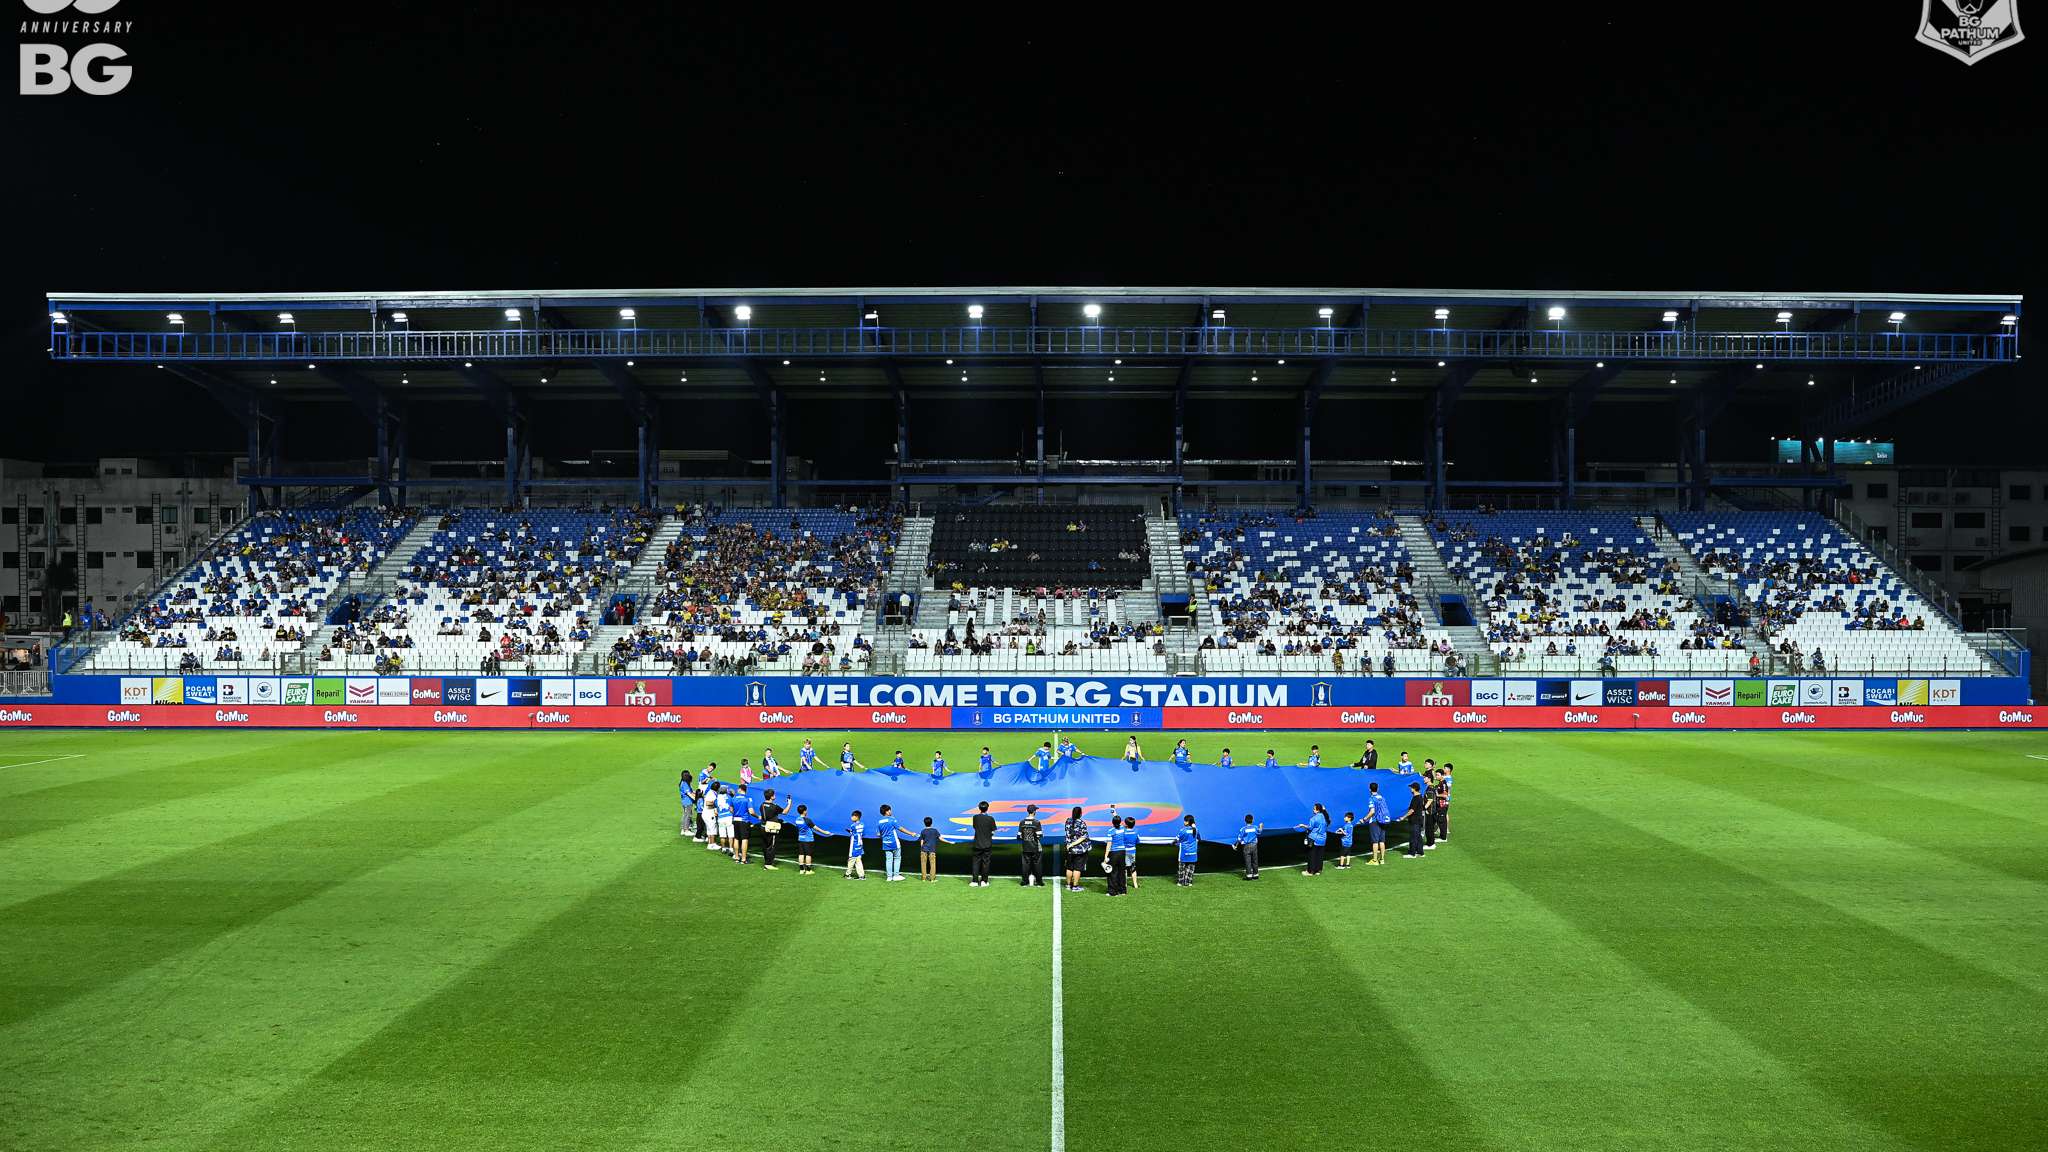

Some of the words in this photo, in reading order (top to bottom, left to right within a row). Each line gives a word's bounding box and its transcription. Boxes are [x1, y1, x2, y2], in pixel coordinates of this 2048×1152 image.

[124, 687, 147, 697] KDT
[287, 688, 308, 696] EURO
[316, 689, 340, 699] Reparil
[412, 688, 441, 699] GoMuc
[579, 691, 602, 699] BGC
[790, 684, 978, 706] WELCOME
[985, 684, 1037, 706] TO
[1046, 681, 1111, 706] BG
[1119, 684, 1288, 706] STADIUM
[1476, 692, 1499, 700] BGC
[1606, 688, 1633, 696] ASSET
[1638, 690, 1666, 701] GoMuc
[1737, 691, 1761, 701] Reparil
[1773, 690, 1794, 698] EURO
[1933, 689, 1957, 699] KDT
[0, 709, 33, 721] GoMuc
[107, 710, 140, 722] GoMuc
[215, 710, 249, 722] GoMuc
[324, 710, 358, 722] GoMuc
[433, 710, 468, 723] GoMuc
[536, 711, 570, 723] GoMuc
[647, 711, 682, 723] GoMuc
[759, 711, 794, 724] GoMuc
[871, 711, 907, 724] GoMuc
[993, 713, 1012, 724] BG
[1014, 713, 1069, 724] PATHUM
[1071, 713, 1120, 724] UNITED
[1228, 711, 1263, 724] GoMuc
[1340, 711, 1376, 724] GoMuc
[1452, 711, 1488, 723] GoMuc
[1564, 711, 1599, 723] GoMuc
[1671, 711, 1706, 723] GoMuc
[1781, 711, 1816, 723] GoMuc
[1890, 711, 1924, 723] GoMuc
[1999, 711, 2033, 723] GoMuc
